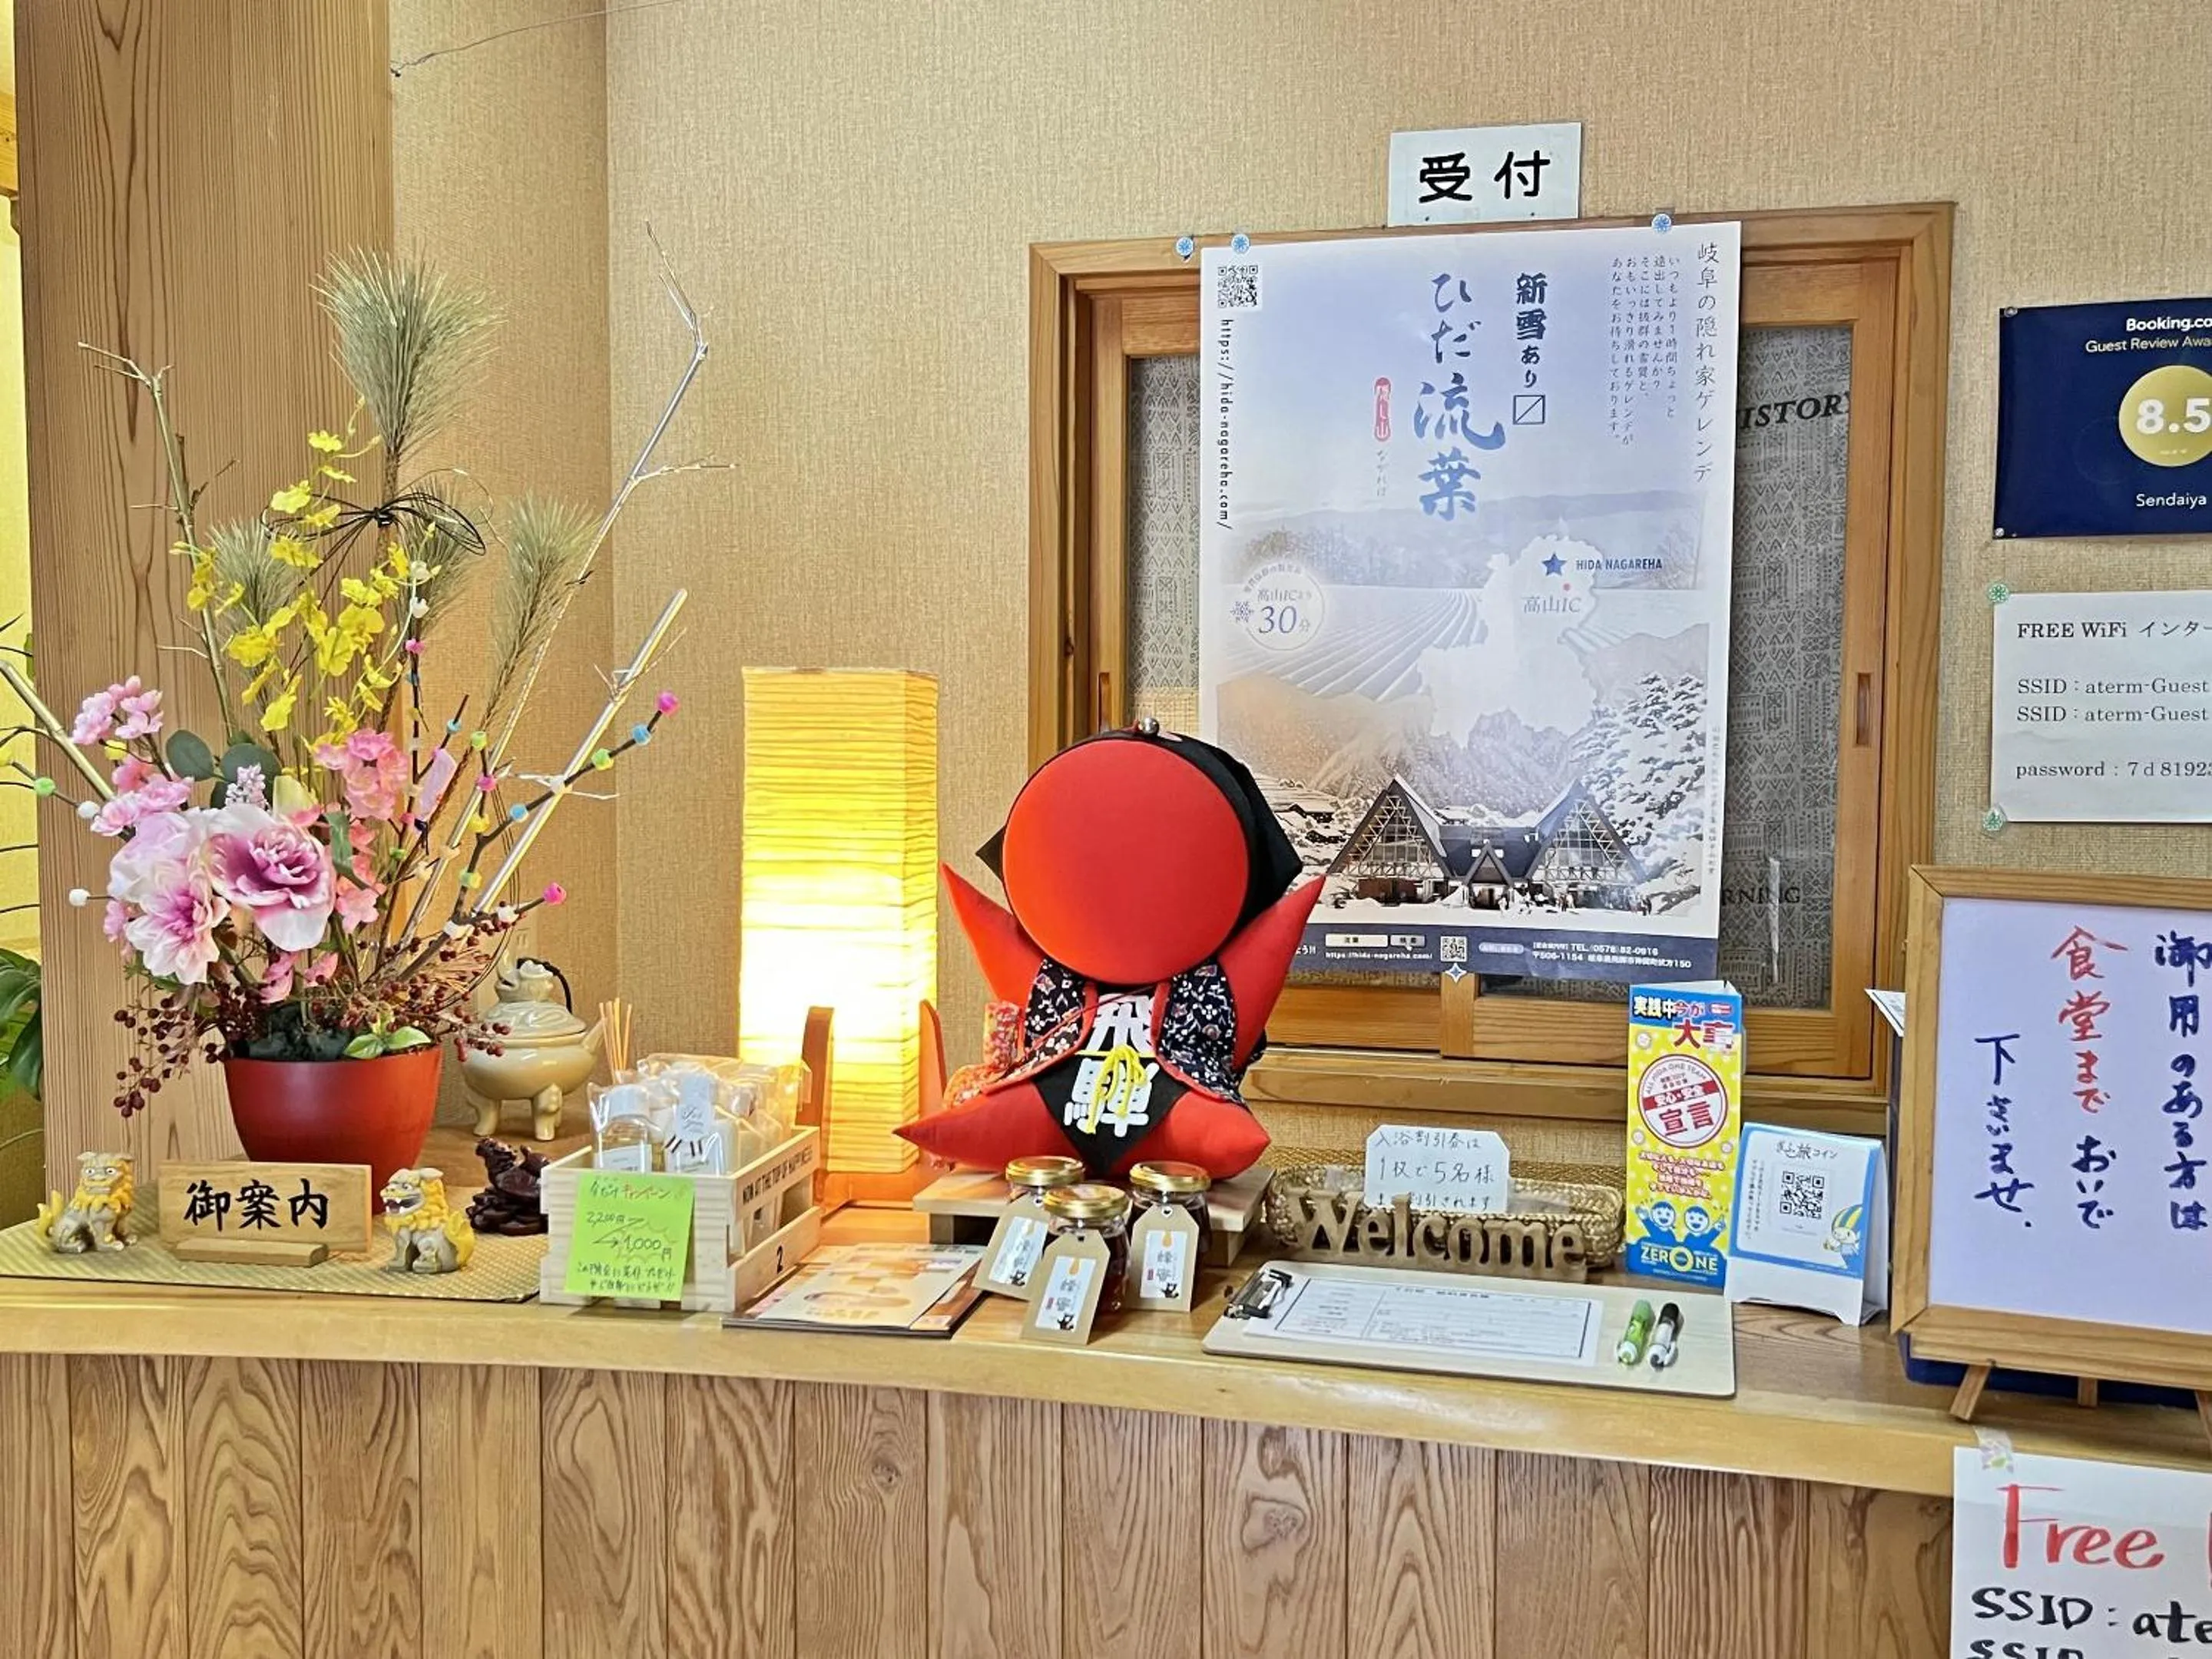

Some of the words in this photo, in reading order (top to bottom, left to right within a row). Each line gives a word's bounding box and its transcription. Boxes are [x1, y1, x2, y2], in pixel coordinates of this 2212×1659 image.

[1419, 150, 1551, 204] 受付
[1515, 273, 1548, 389] 新雪あり
[2085, 340, 2127, 353] Guest
[2131, 337, 2179, 349] Review
[1694, 242, 1719, 482] 岐阜の隠れ家ゲレンデ
[1413, 273, 1506, 522] ひだ流葉
[1737, 390, 1850, 430] ISTOR
[2136, 397, 2211, 434] 8.5
[1217, 319, 1234, 530] https://hida-nagareha.com/
[2136, 492, 2207, 509] Sendaiya
[1576, 559, 1601, 570] HIDA
[1605, 558, 1662, 570] NAGAREHA
[2017, 623, 2075, 638] FREE
[2081, 621, 2128, 638] WiFi
[2016, 761, 2105, 780] password
[184, 1177, 329, 1232] 御案内
[1286, 1189, 1586, 1271] Welcome
[1996, 1484, 2164, 1569] Free
[1972, 1587, 2094, 1630] SSID
